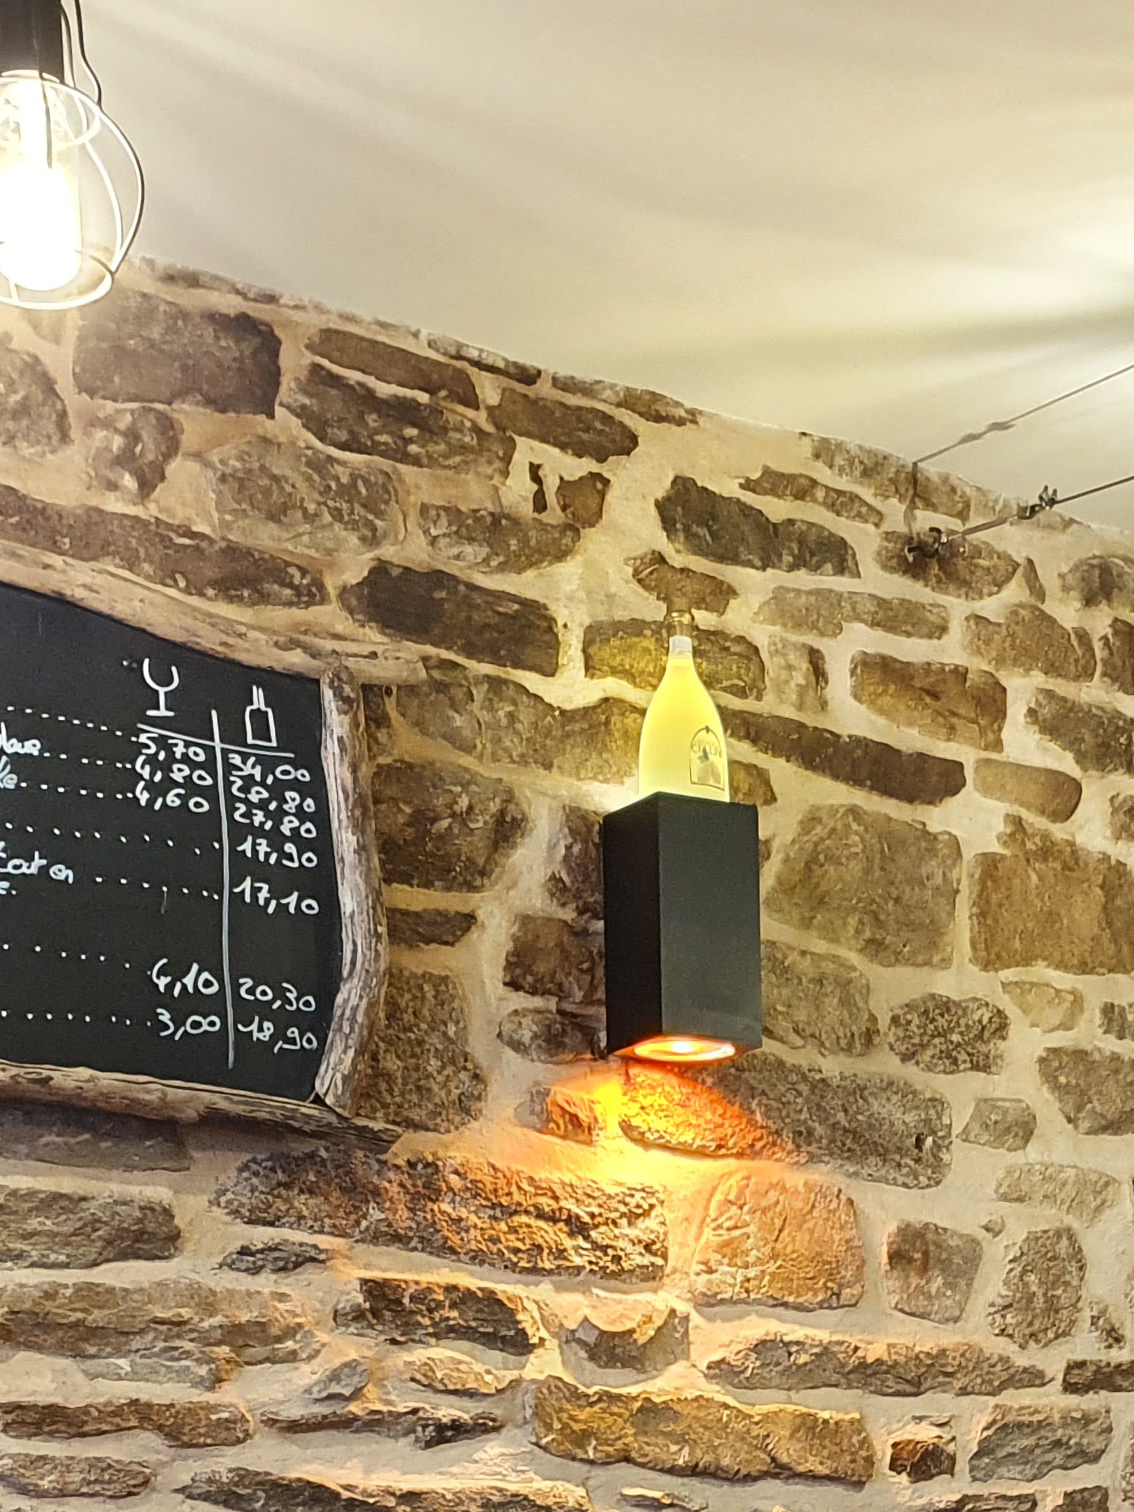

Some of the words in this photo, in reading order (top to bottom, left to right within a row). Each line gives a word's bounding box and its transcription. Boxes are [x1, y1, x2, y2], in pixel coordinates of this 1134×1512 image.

[228, 753, 312, 785] 34,00
[135, 780, 210, 813] 4,60
[236, 835, 318, 868] 17,90
[233, 876, 320, 914] 17,10
[152, 958, 220, 998] 4,10
[239, 978, 316, 1011] 20,30
[156, 1008, 221, 1041] 3,00
[237, 1015, 318, 1054] 18,90
